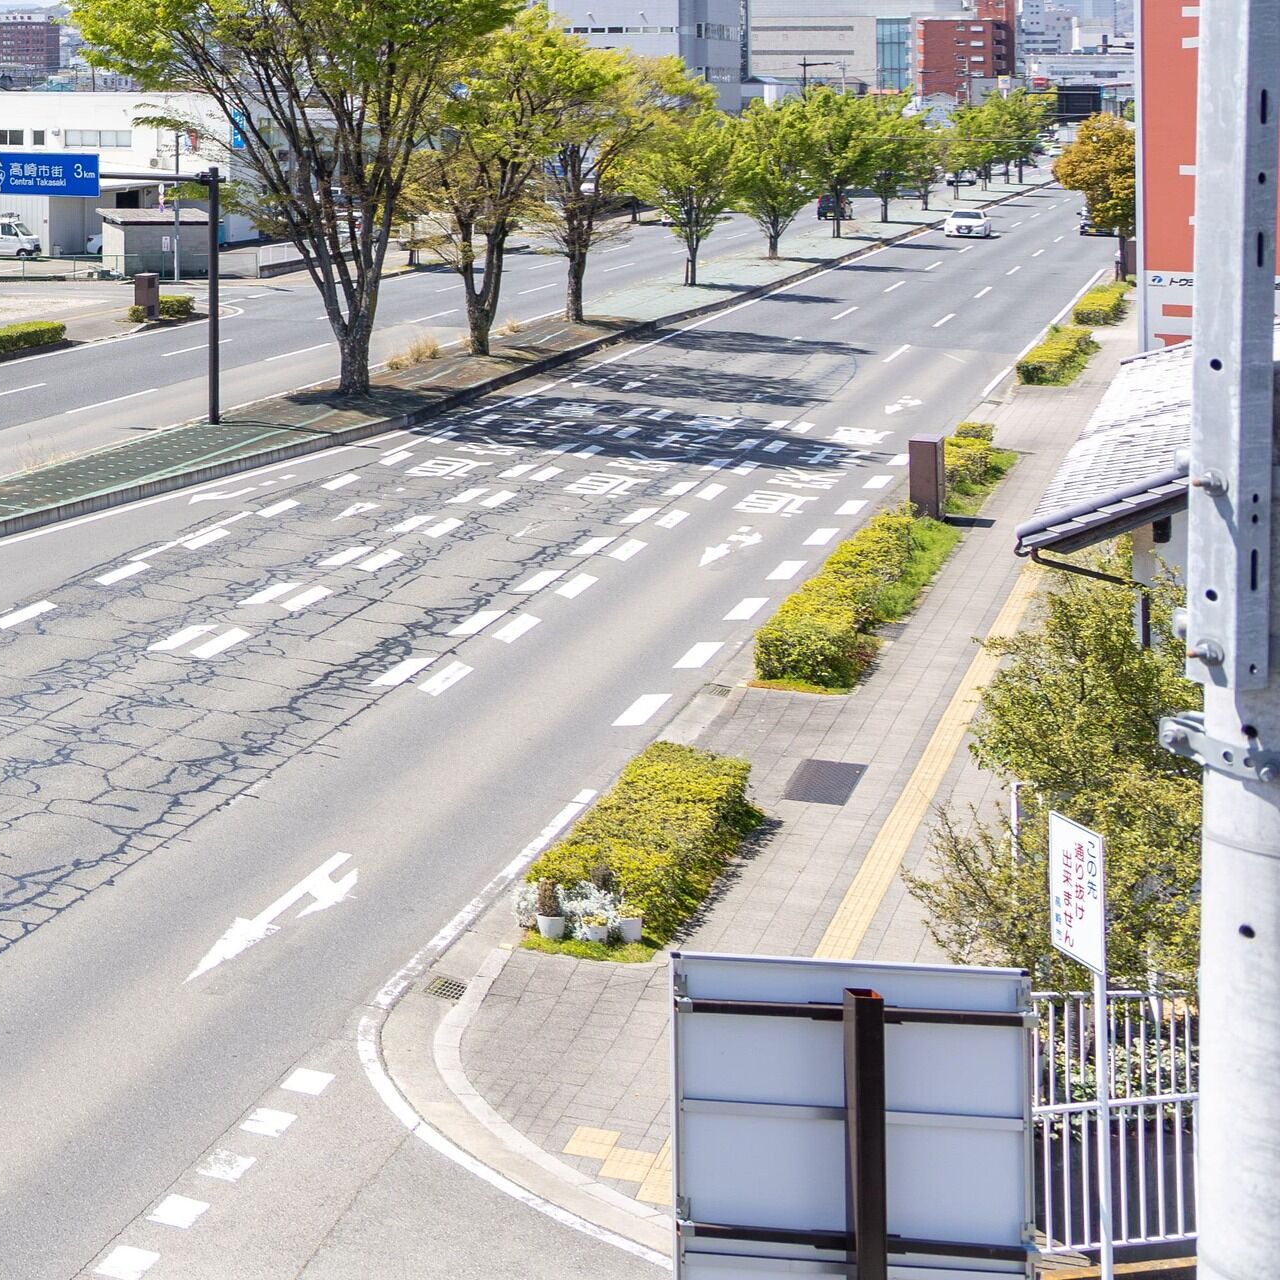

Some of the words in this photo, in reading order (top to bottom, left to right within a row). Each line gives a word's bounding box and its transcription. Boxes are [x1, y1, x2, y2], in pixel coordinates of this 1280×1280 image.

[9, 162, 63, 177] 高崎市街
[9, 177, 34, 186] Central
[36, 178, 67, 187] Takasaki
[1062, 848, 1075, 948] 出来ません
